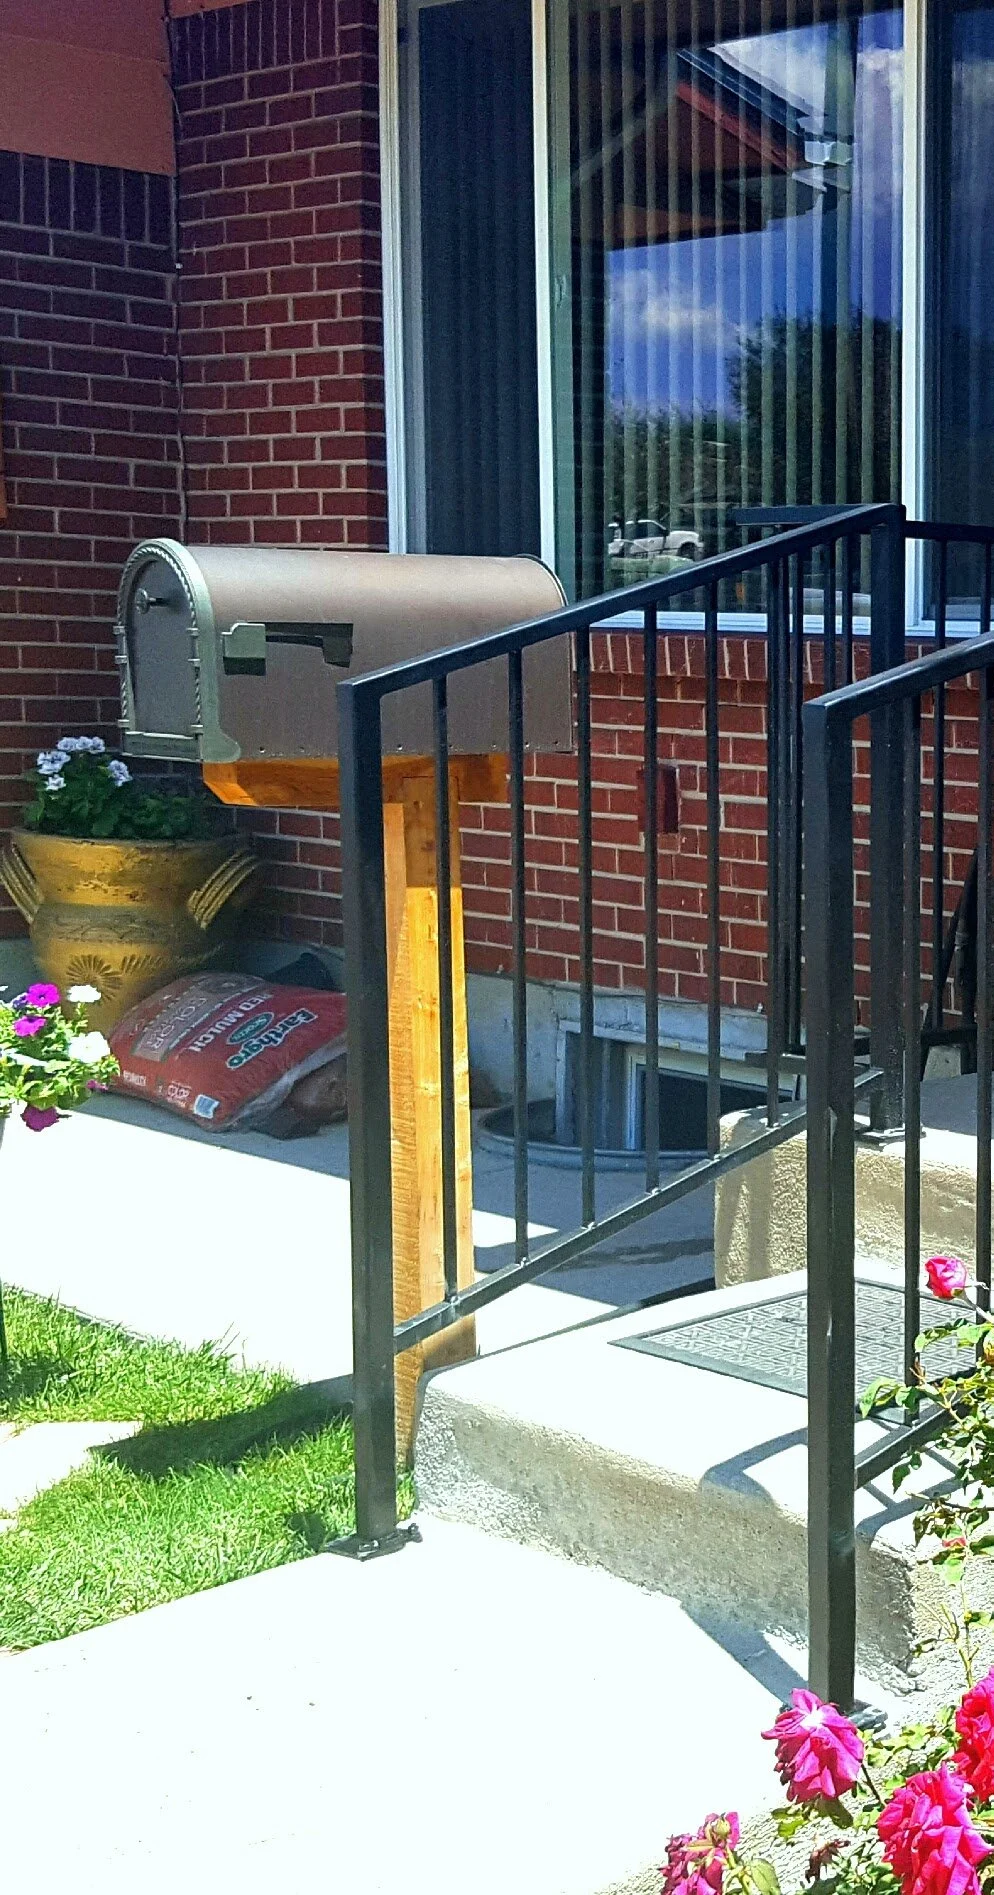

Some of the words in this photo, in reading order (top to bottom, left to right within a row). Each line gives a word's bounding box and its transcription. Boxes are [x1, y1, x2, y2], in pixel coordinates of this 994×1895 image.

[152, 996, 208, 1051] COLOR
[190, 1009, 244, 1052] MULCH
[226, 1007, 319, 1070] Earthgro
